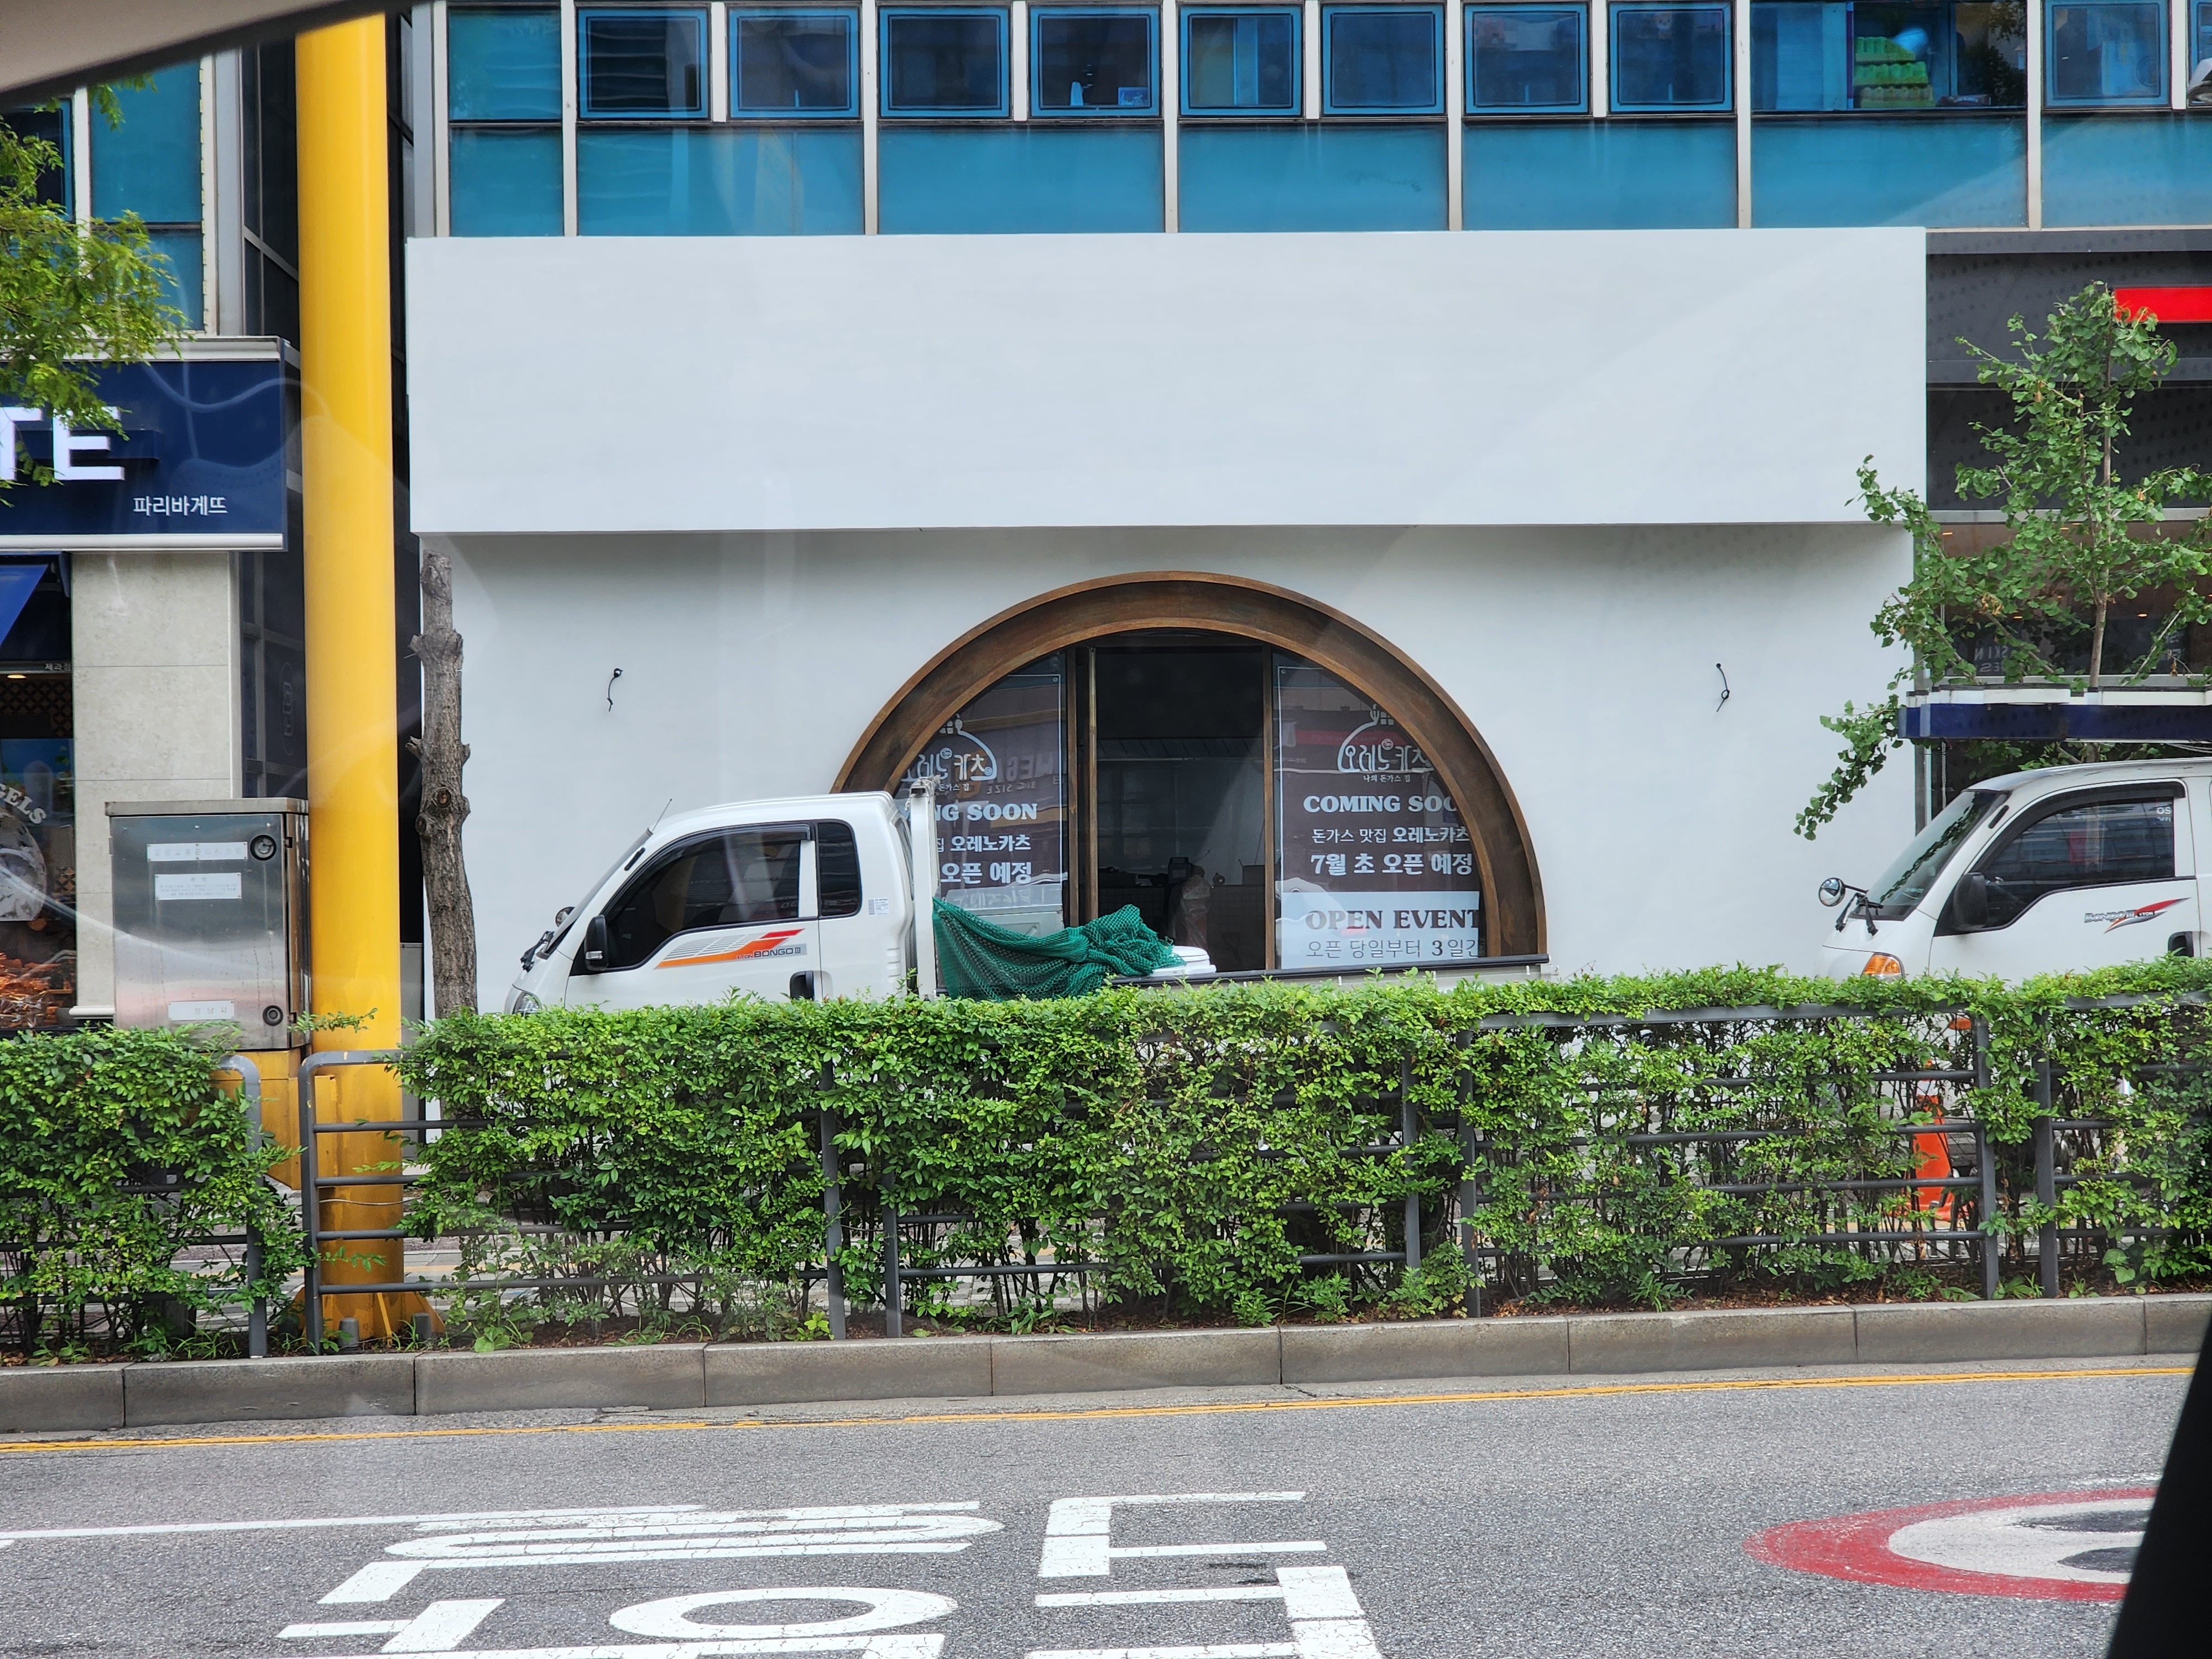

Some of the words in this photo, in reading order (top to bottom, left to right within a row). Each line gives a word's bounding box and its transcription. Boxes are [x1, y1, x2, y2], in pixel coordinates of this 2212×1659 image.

[133, 495, 228, 517] 파리바게뜨
[962, 783, 969, 791] 집
[1363, 774, 1378, 782] 나의
[1380, 774, 1401, 782] 돈가스
[967, 803, 1037, 821] SOON
[1303, 795, 1401, 812] COMING
[950, 834, 1031, 852] 오레노카츠
[1311, 828, 1355, 843] 돈가스
[1359, 828, 1386, 843] 맛집
[1392, 827, 1470, 843] 오레노카츠
[941, 862, 983, 884] 오픈
[989, 862, 1031, 884] 예정
[1311, 853, 1347, 876] 7월
[1354, 853, 1375, 874] 초
[1382, 853, 1425, 875] 오픈
[1431, 853, 1473, 875] 예정
[1305, 910, 1383, 930] OPEN
[1393, 909, 1479, 929] EVENT
[754, 948, 794, 958] BONGO
[1306, 940, 1342, 958] 오픈
[1350, 940, 1420, 959] 당일부터
